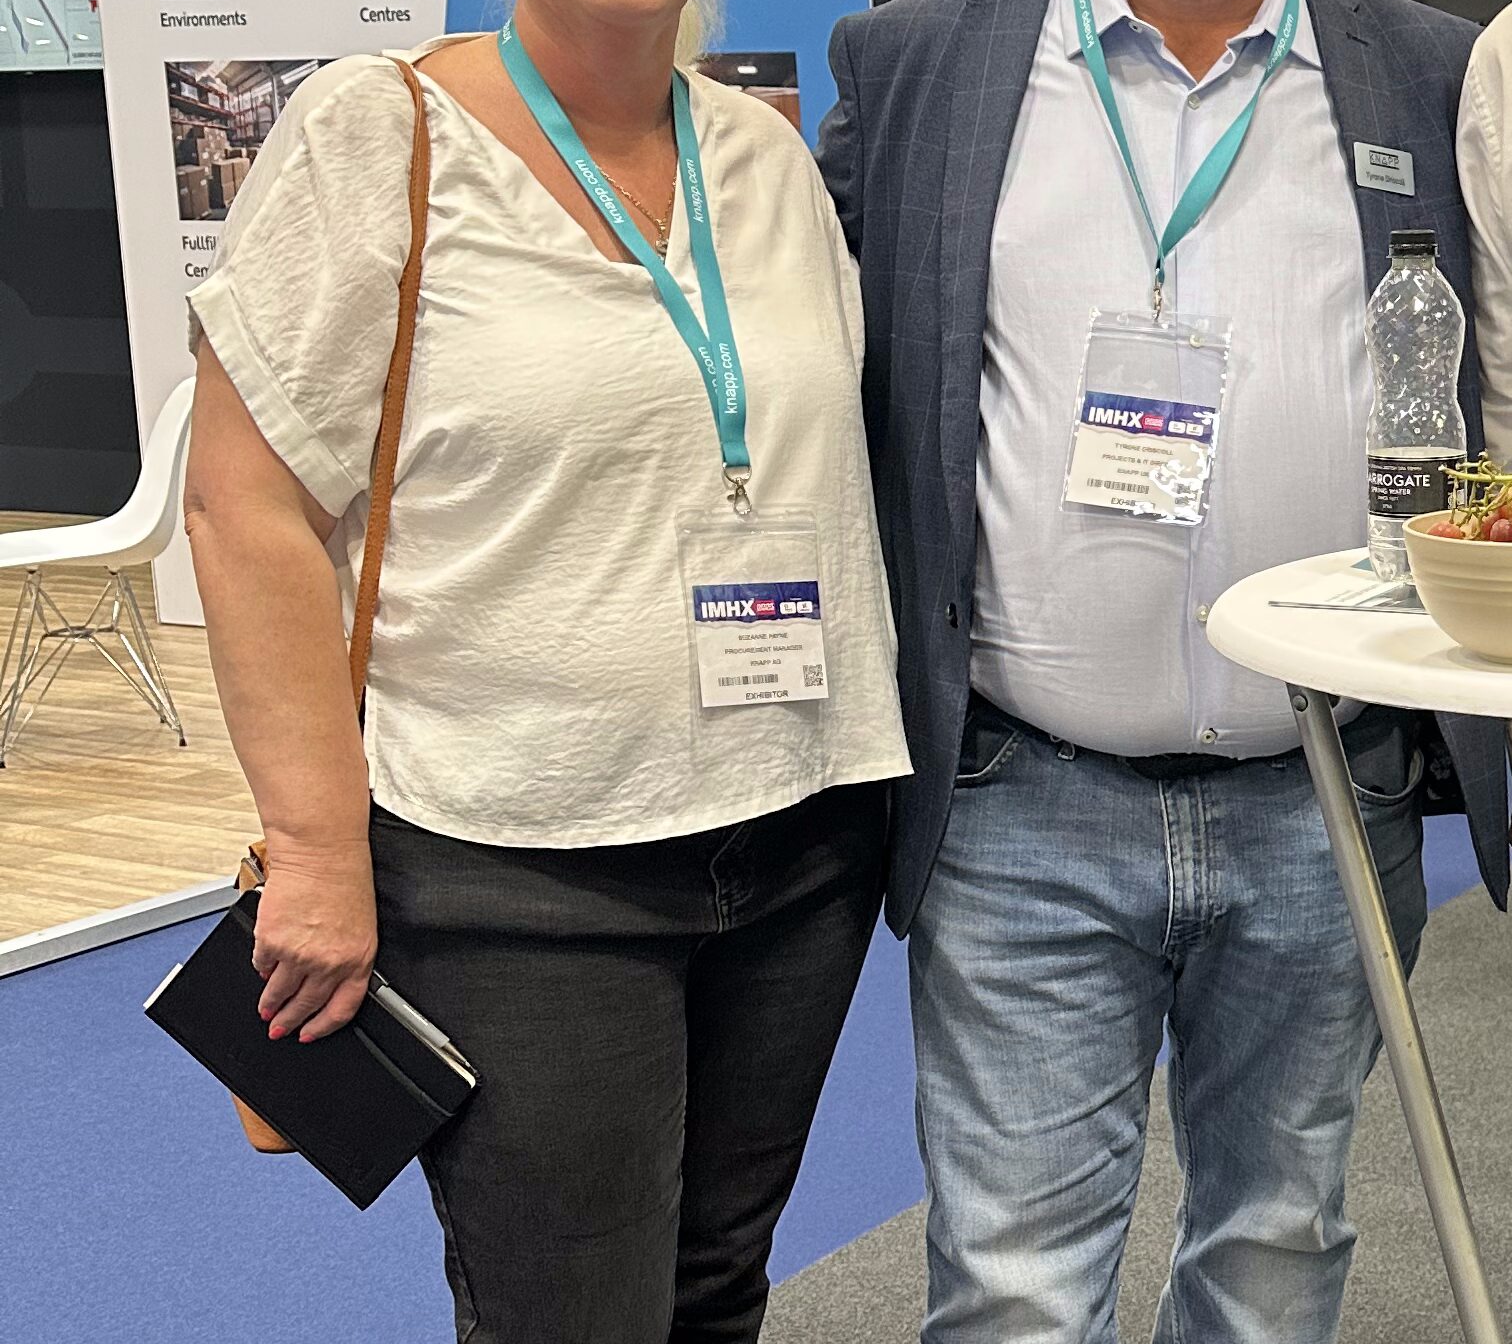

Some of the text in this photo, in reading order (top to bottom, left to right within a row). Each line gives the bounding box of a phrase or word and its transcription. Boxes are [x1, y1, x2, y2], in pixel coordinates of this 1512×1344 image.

[160, 11, 247, 27] Environments
[360, 6, 411, 23] Centres
[575, 159, 625, 224] knapp.com
[686, 159, 704, 223] knapp.com
[181, 235, 217, 251] Fullfil
[718, 343, 738, 414] knapp.com
[1088, 407, 1144, 429] IMHX
[1368, 472, 1431, 487] ARROGATE
[701, 599, 756, 618] IMHX
[745, 689, 788, 701] EXHIBITOR
